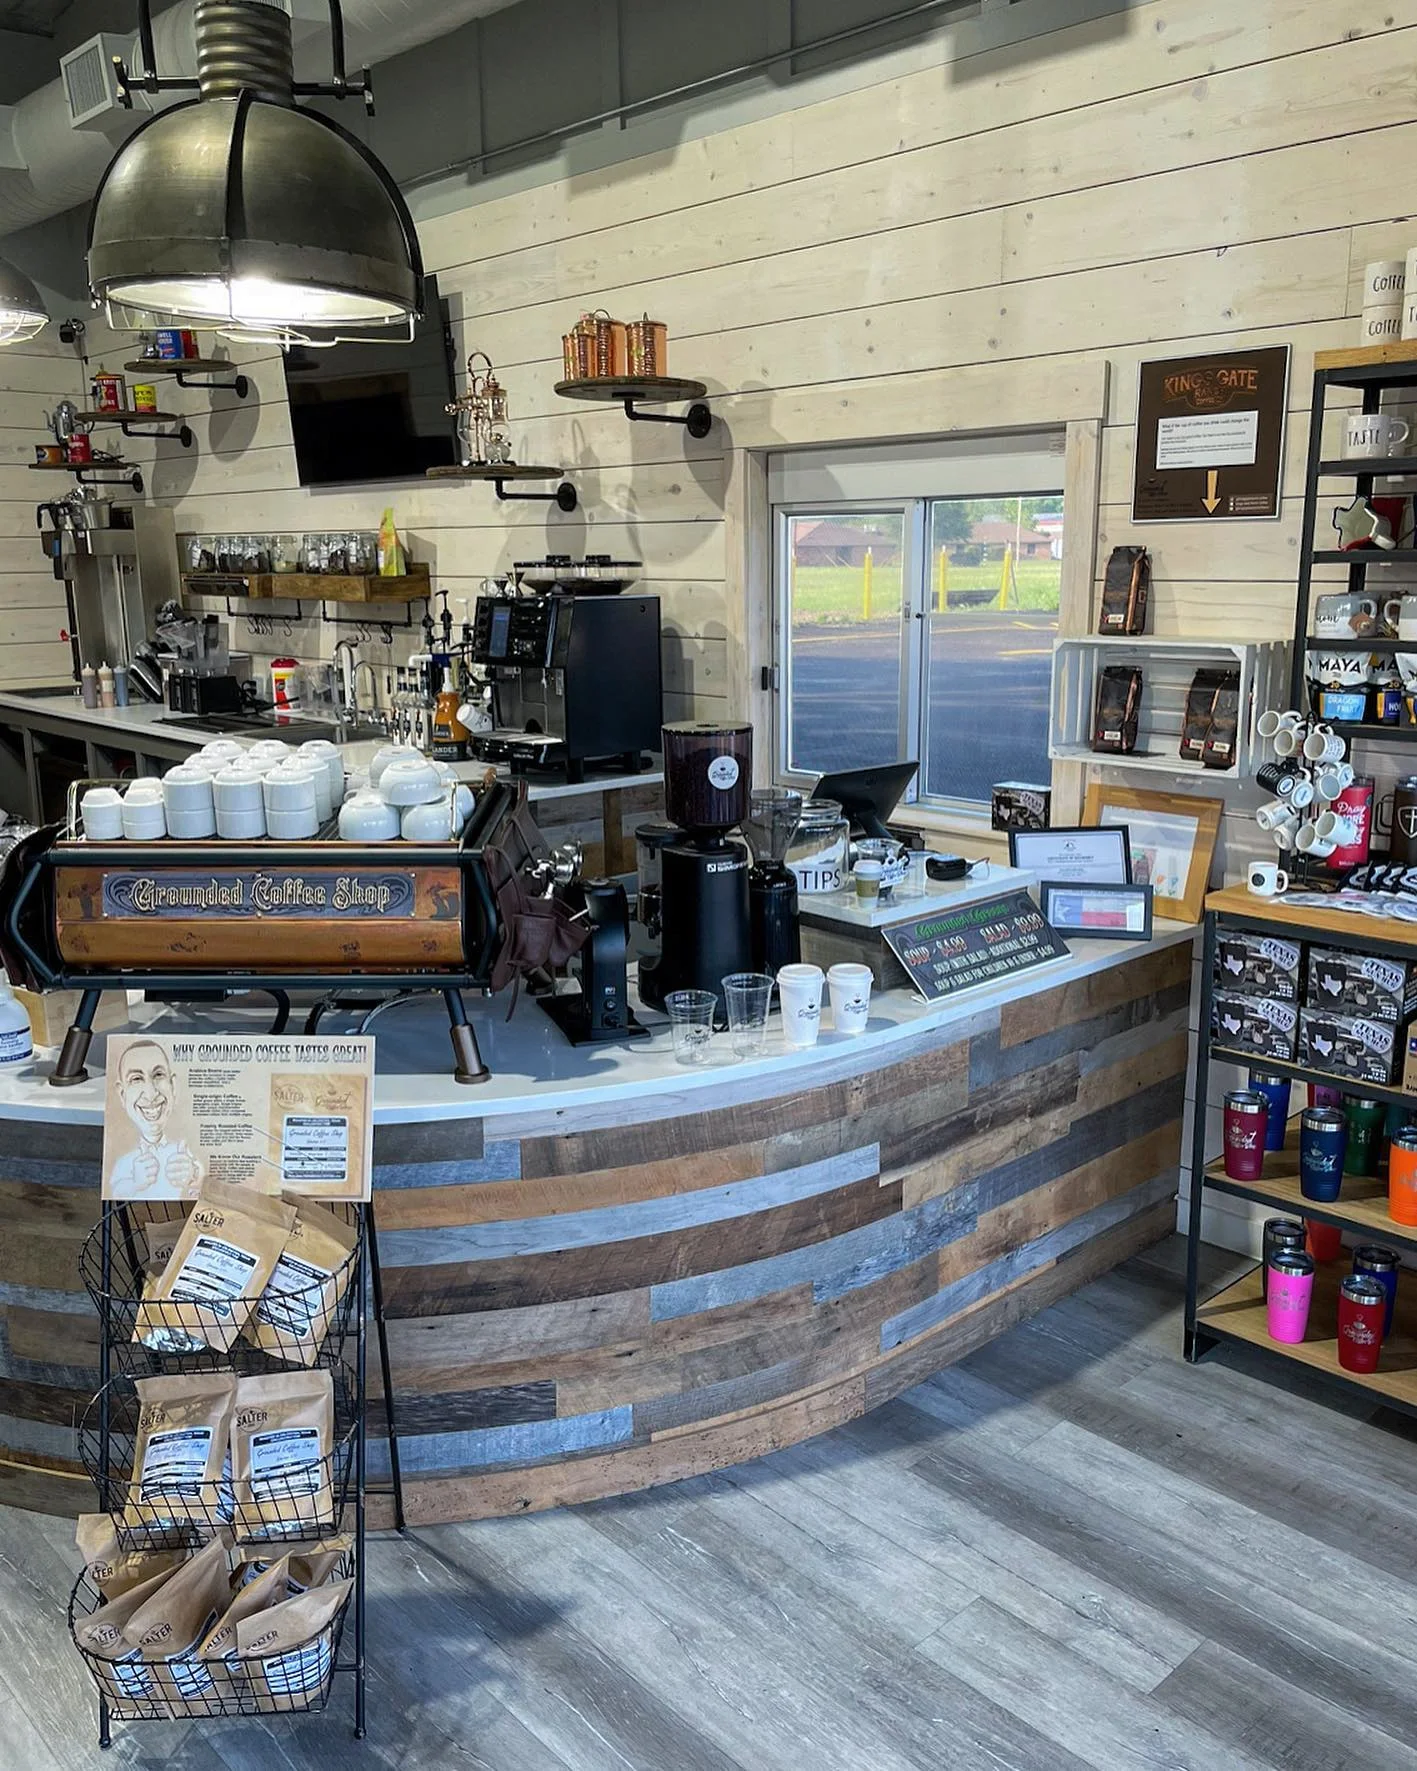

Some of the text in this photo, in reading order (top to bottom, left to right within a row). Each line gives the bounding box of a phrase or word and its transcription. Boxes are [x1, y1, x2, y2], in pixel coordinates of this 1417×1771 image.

[1216, 370, 1259, 391] GATE
[1347, 429, 1380, 447] TASTE
[1320, 658, 1361, 674] MAYA
[1337, 801, 1367, 814] Pray
[800, 868, 841, 890] TIPS
[129, 877, 392, 913] Grounded Coffee Shop
[979, 922, 1011, 944] SALAD
[903, 947, 931, 967] SOUP
[1268, 941, 1297, 962] TEXAS
[1369, 961, 1401, 982] TEXAS
[1265, 1002, 1293, 1023] TEXAS
[1360, 1022, 1390, 1045] TEXAS
[173, 1044, 367, 1064] WHY GROUNDED COFFEE TASTES GREAT!
[193, 1212, 225, 1229] SALTER
[140, 1412, 166, 1429] SALTER
[236, 1411, 269, 1428] SALTER
